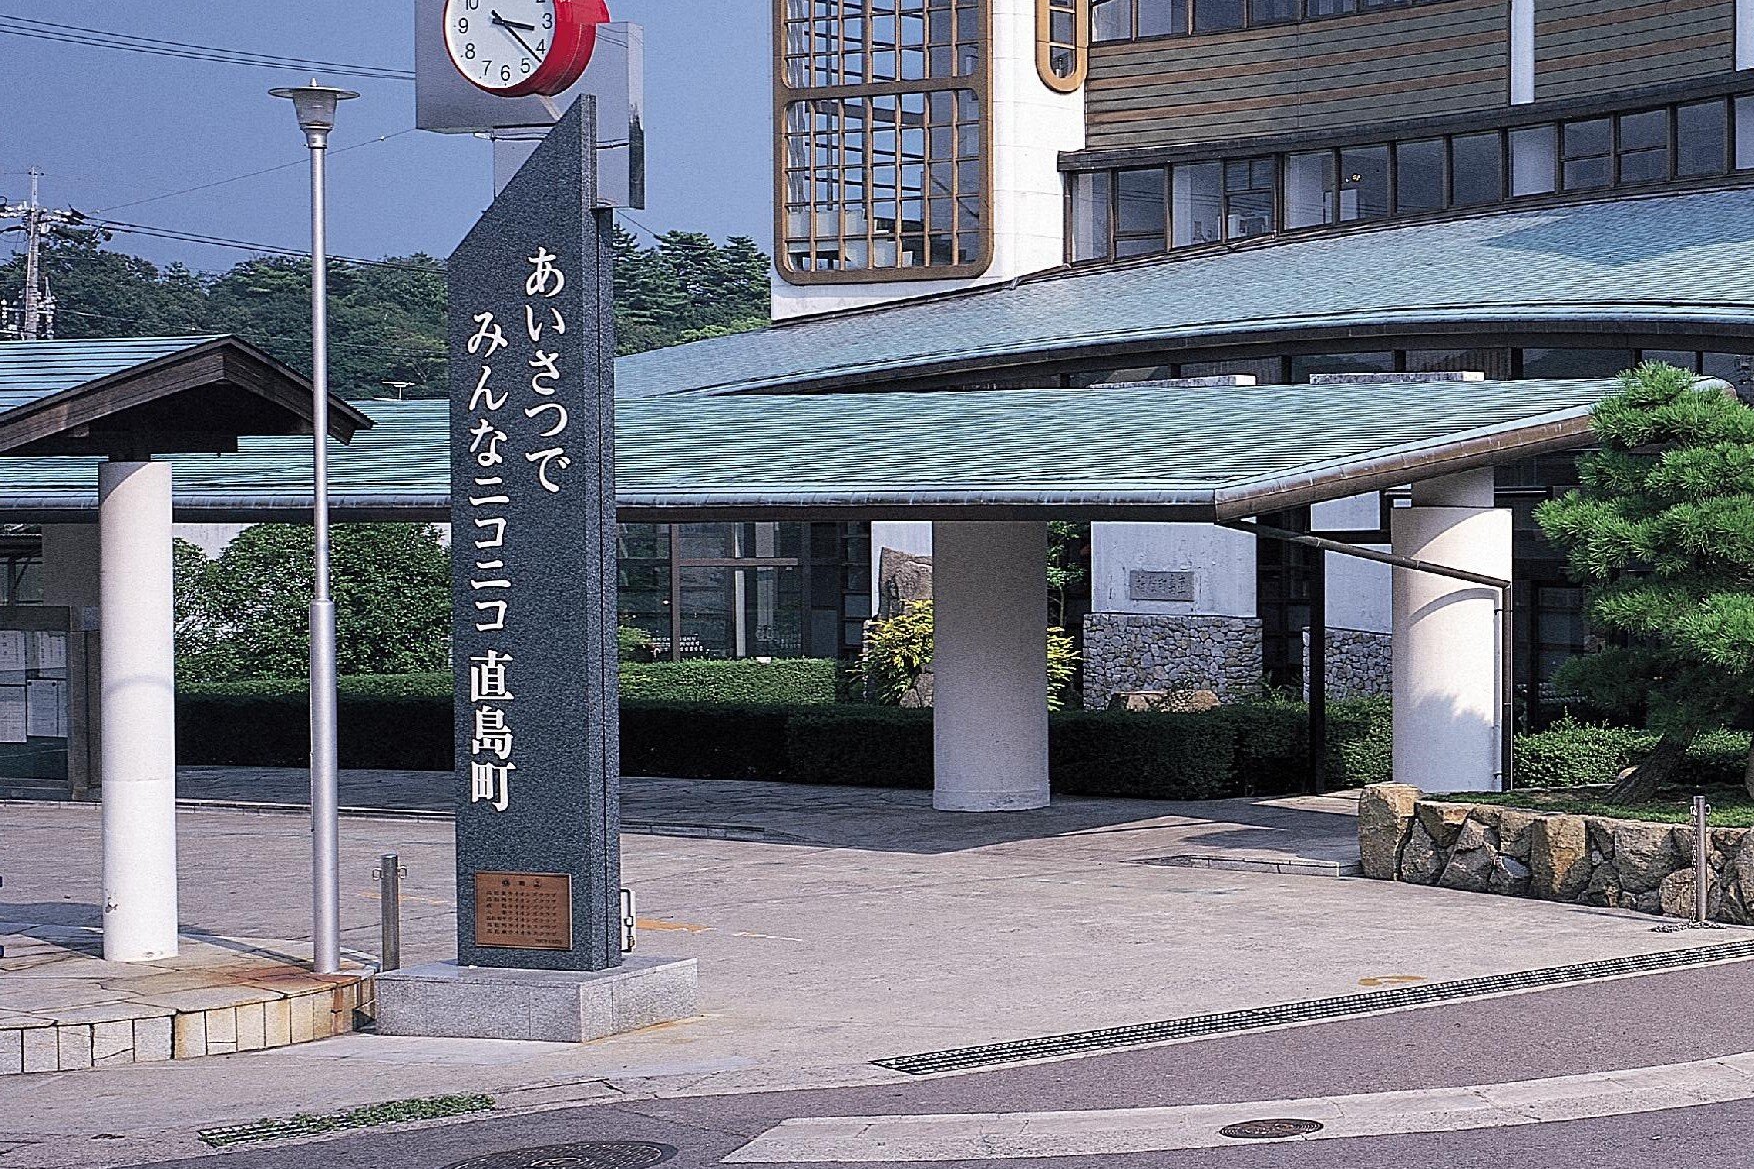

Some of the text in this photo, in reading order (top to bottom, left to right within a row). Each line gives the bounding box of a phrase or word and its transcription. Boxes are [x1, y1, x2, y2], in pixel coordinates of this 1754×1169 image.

[458, 17, 469, 34] 9
[541, 12, 553, 30] 3
[464, 42, 476, 60] 8
[535, 38, 546, 56] 4
[482, 60, 493, 76] 7
[500, 64, 511, 82] 6
[520, 57, 531, 74] 5
[523, 245, 572, 494] あいさつで
[466, 310, 517, 813] みんなニコニコ 直島町
